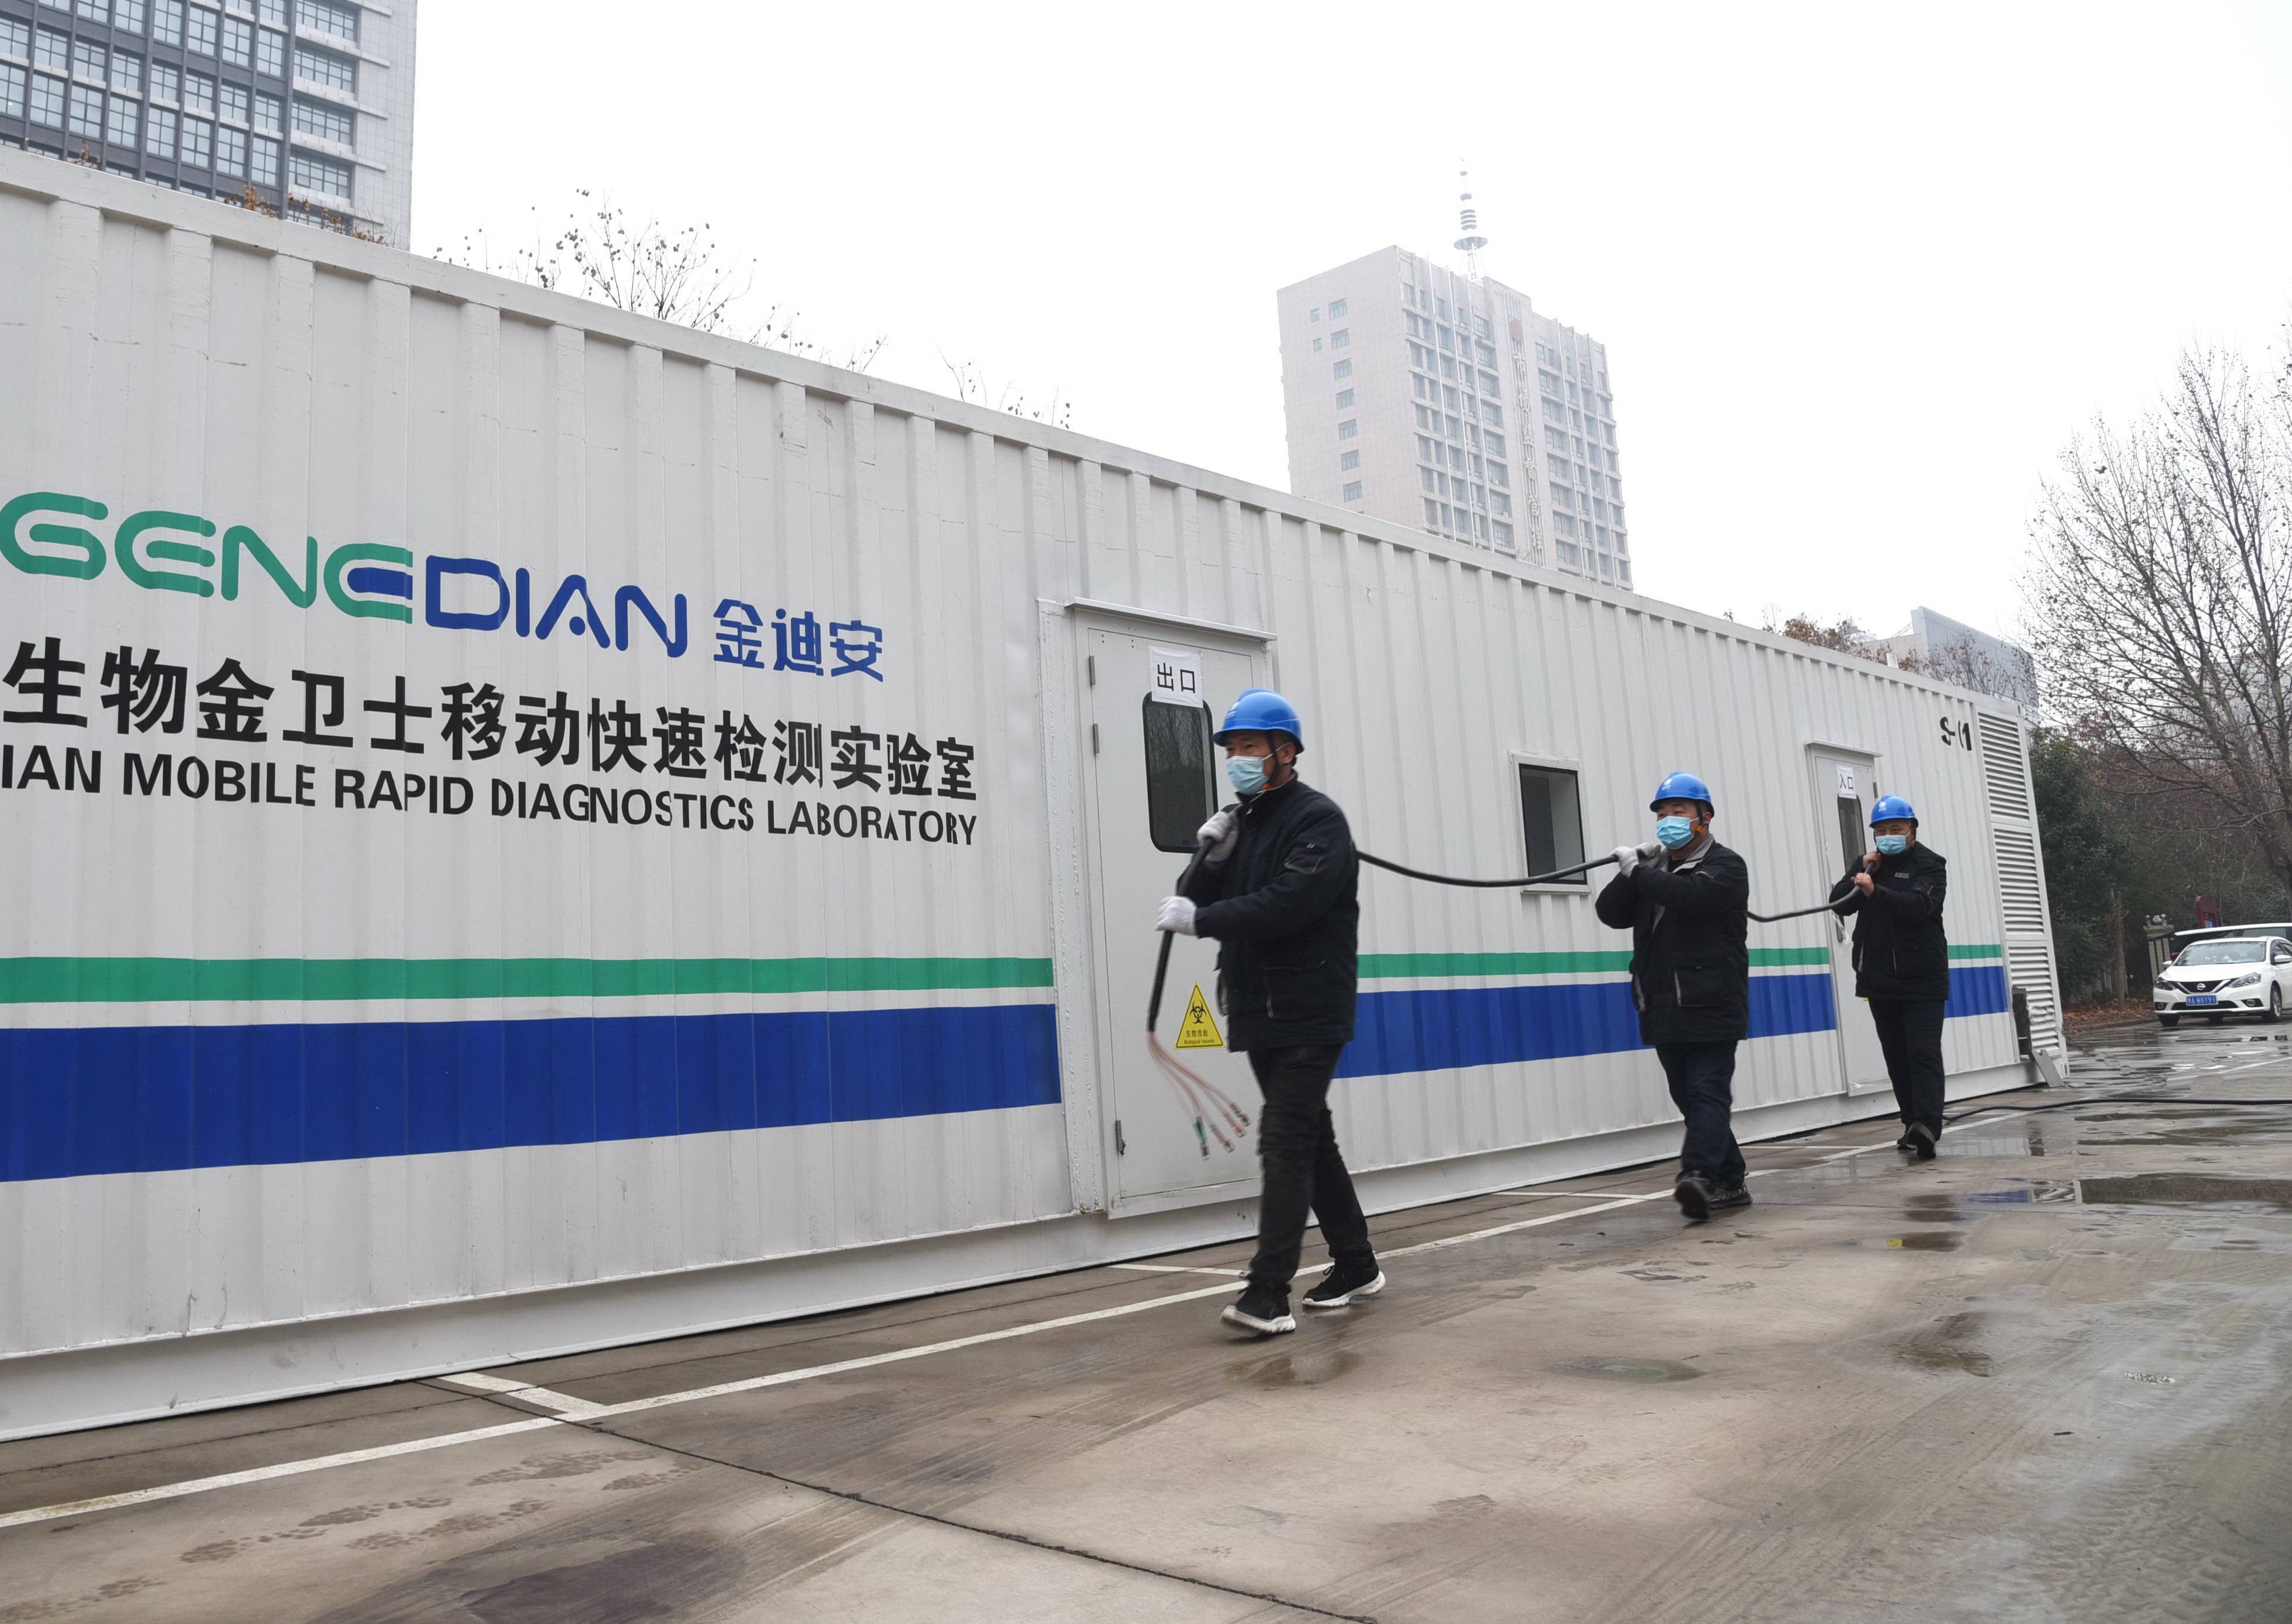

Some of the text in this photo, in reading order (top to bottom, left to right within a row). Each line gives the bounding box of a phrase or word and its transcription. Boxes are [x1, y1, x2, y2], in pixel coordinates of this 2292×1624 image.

[713, 598, 884, 682] 金迪安
[1157, 662, 1196, 694] 出口
[2, 636, 977, 801] 生物金卫士移动快速检测实验室
[2, 744, 977, 846] IAN MOBILE RAPID DIAGNOSTICS LABORATORY
[1840, 773, 1853, 790] 入口
